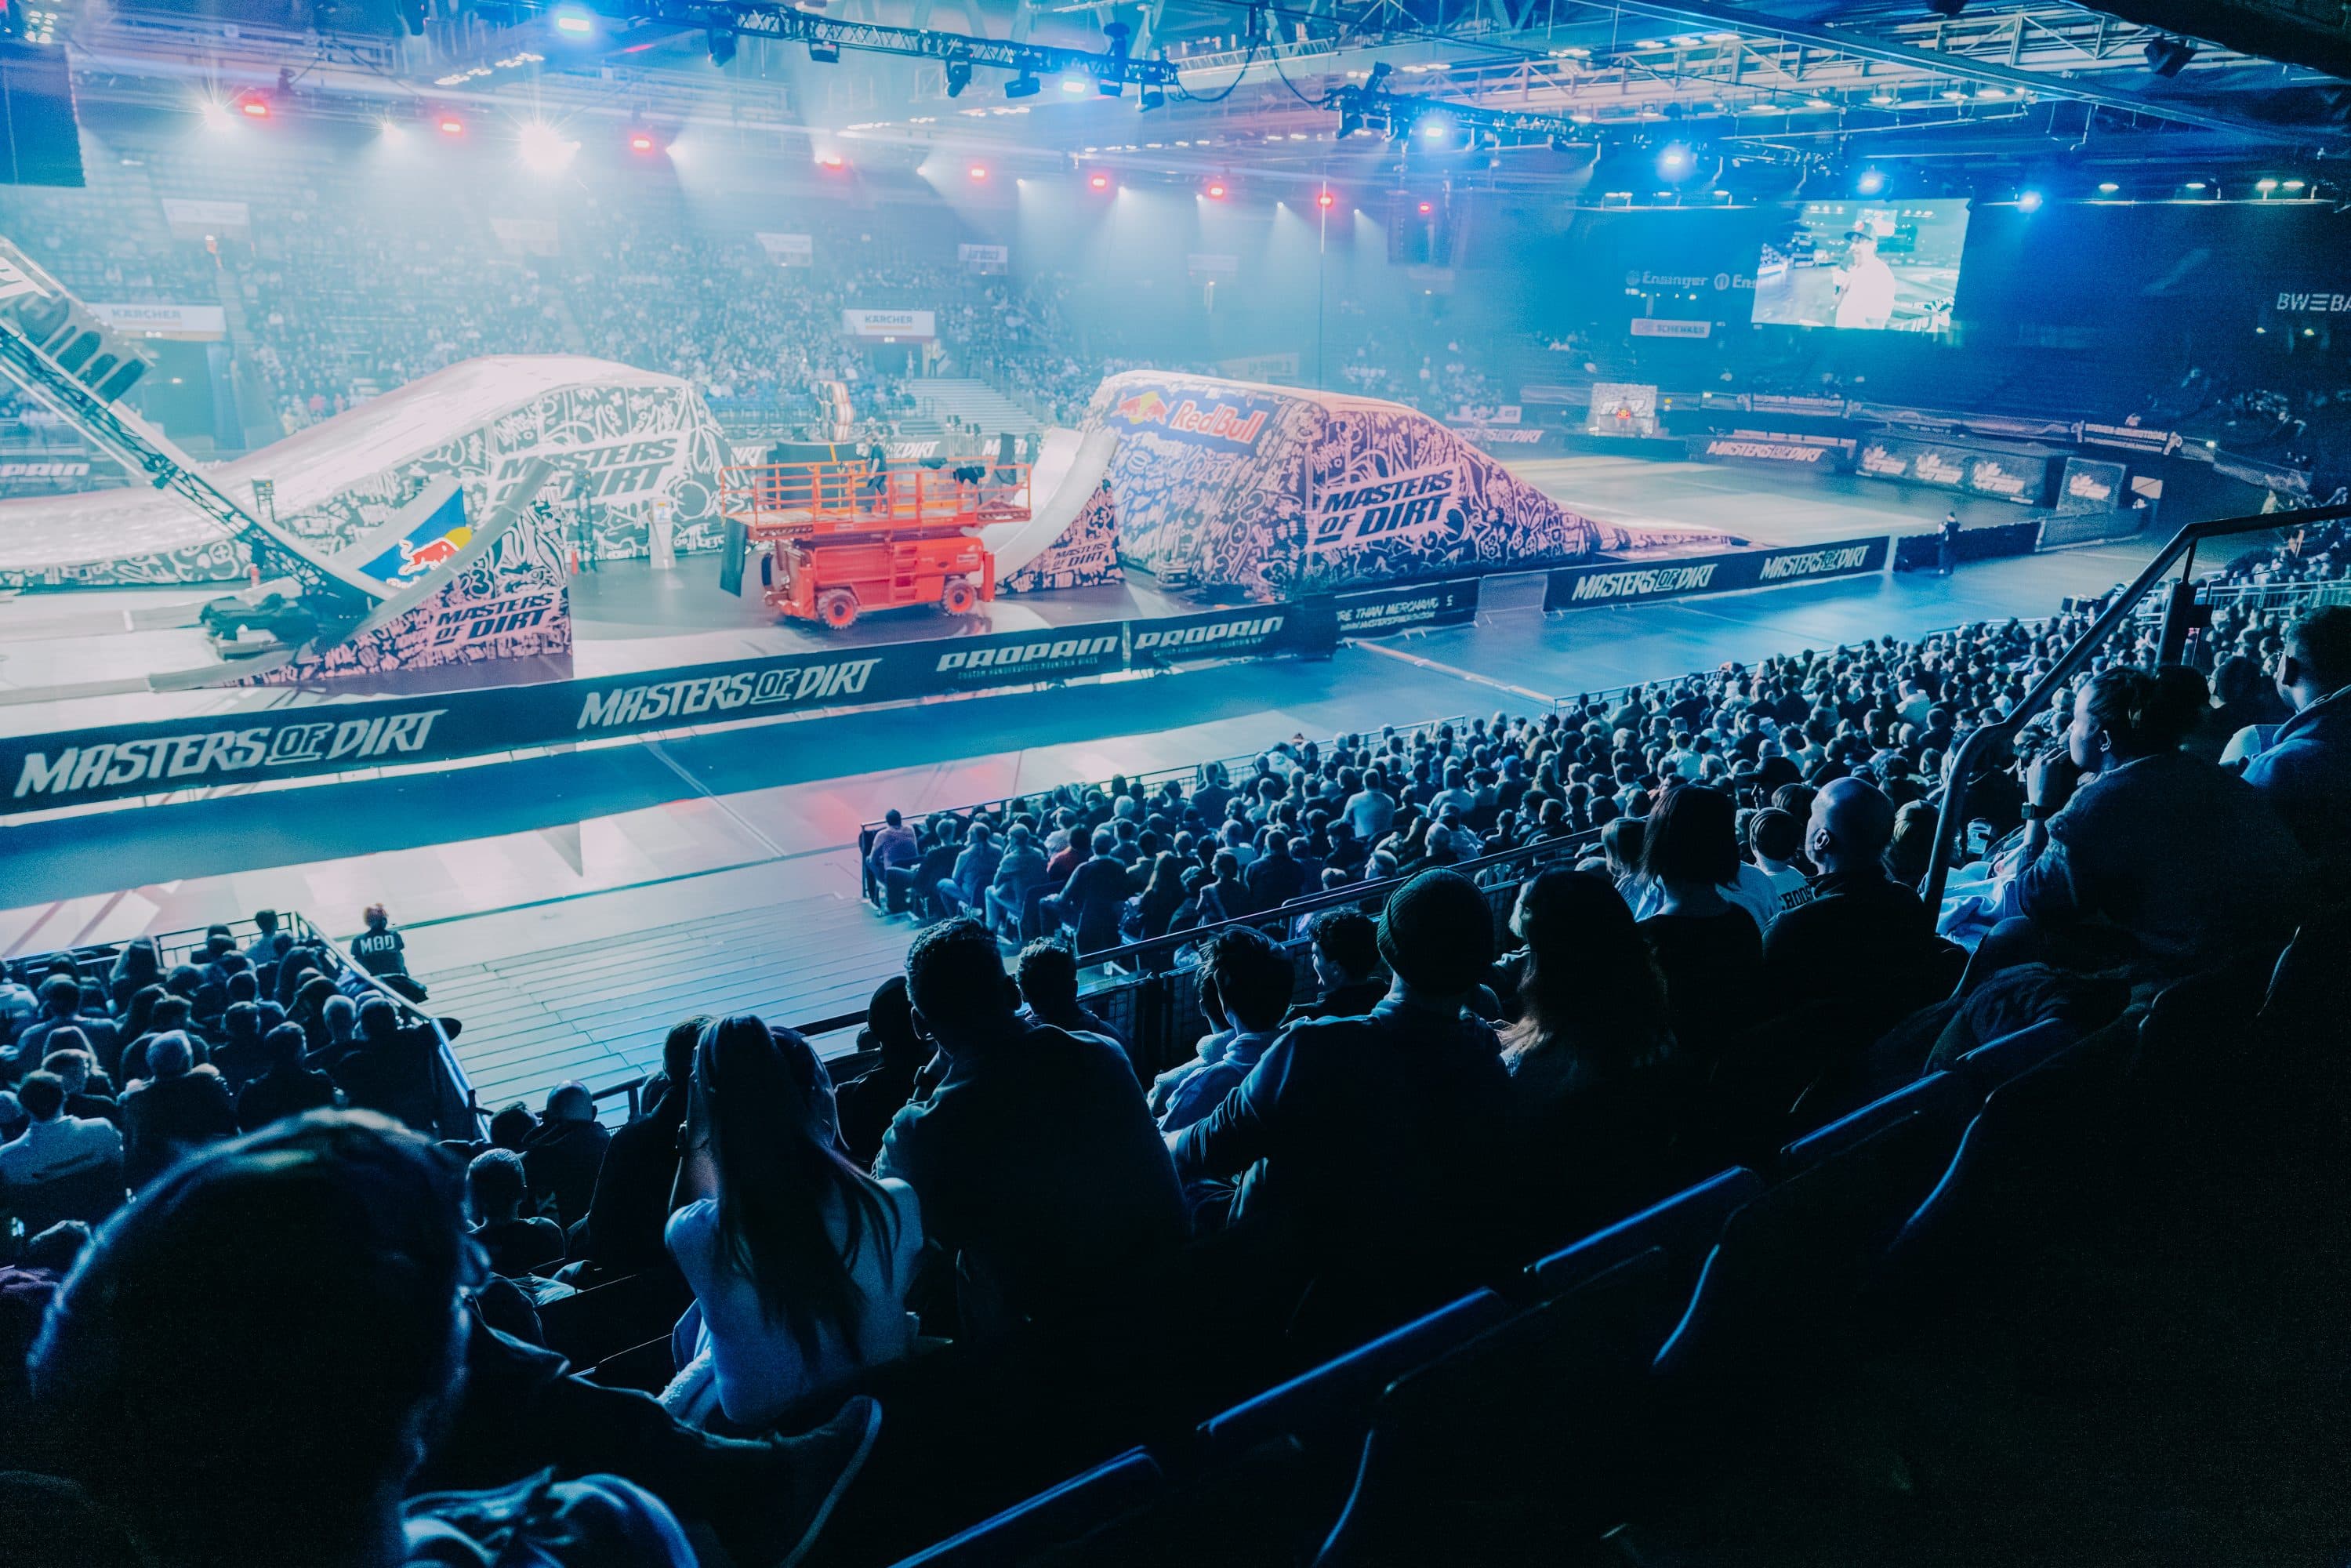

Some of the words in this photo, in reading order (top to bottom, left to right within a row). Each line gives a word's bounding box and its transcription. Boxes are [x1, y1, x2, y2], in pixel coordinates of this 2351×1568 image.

[1707, 441, 1774, 458] MASTERS
[1788, 447, 1827, 463] DIRT
[1322, 470, 1453, 514] MASTERS
[1314, 512, 1356, 546] OF
[1356, 491, 1451, 537] DIRT
[1760, 551, 1823, 580] MASTERS
[1837, 545, 1870, 569] DIRT
[1572, 569, 1656, 601] MASTERS
[1653, 568, 1681, 592] OF
[1677, 564, 1718, 590] DIRT
[437, 592, 554, 624] MASTERS
[433, 624, 465, 648] OF
[468, 608, 548, 639] DIRT
[1134, 615, 1284, 650] PROPAIN
[936, 635, 1119, 672] PROPAIN
[577, 672, 759, 730] MASTERS
[749, 668, 796, 704] OF
[793, 658, 883, 701] DIRT
[13, 726, 273, 797] MASTERS
[264, 721, 335, 766] OF
[326, 709, 449, 759] DIRT
